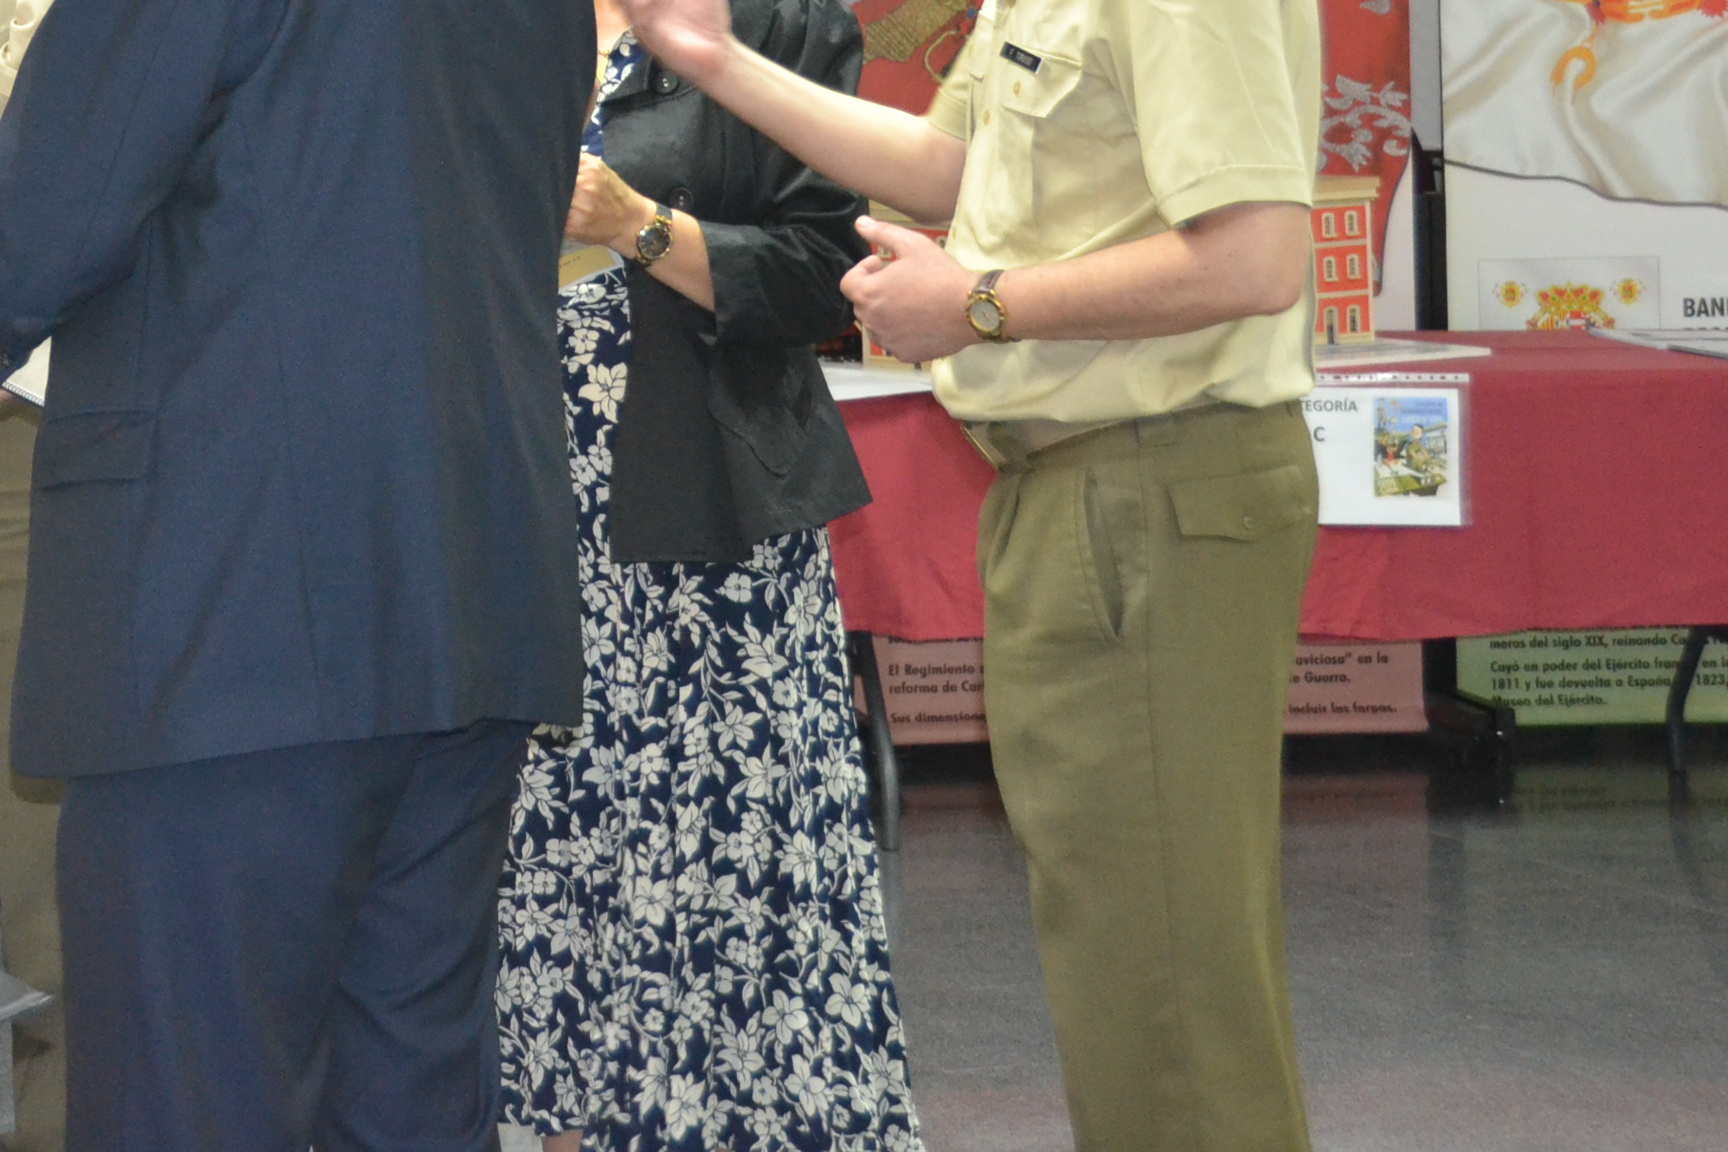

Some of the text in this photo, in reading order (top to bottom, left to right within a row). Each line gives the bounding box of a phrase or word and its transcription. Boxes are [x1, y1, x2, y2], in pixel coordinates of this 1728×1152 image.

[1683, 297, 1728, 318] BAN
[1314, 426, 1326, 442] C
[1529, 635, 1548, 648] del
[1552, 635, 1582, 650] siglo
[1584, 634, 1608, 648] XIX,
[1612, 633, 1667, 646] reinando
[888, 663, 899, 676] El
[904, 662, 975, 678] Regimiento
[1357, 654, 1372, 664] en
[1377, 652, 1389, 664] la
[1490, 660, 1520, 675] Cayó
[1523, 662, 1539, 672] en
[1542, 659, 1577, 674] poder
[1582, 658, 1601, 670] del
[1605, 658, 1650, 672] Ejército
[1653, 655, 1680, 669] fran
[1702, 660, 1717, 669] en
[889, 681, 938, 694] reforma
[942, 680, 957, 693] de
[961, 680, 984, 692] Car
[1304, 672, 1352, 684] Guerra.
[1492, 677, 1519, 690] 1811
[1524, 680, 1531, 692] y
[1535, 676, 1554, 688] fue
[1558, 675, 1611, 689] devuelta
[1615, 679, 1623, 687] a
[1534, 694, 1554, 706] del
[890, 713, 911, 724] Sus
[915, 712, 987, 723] dimensione
